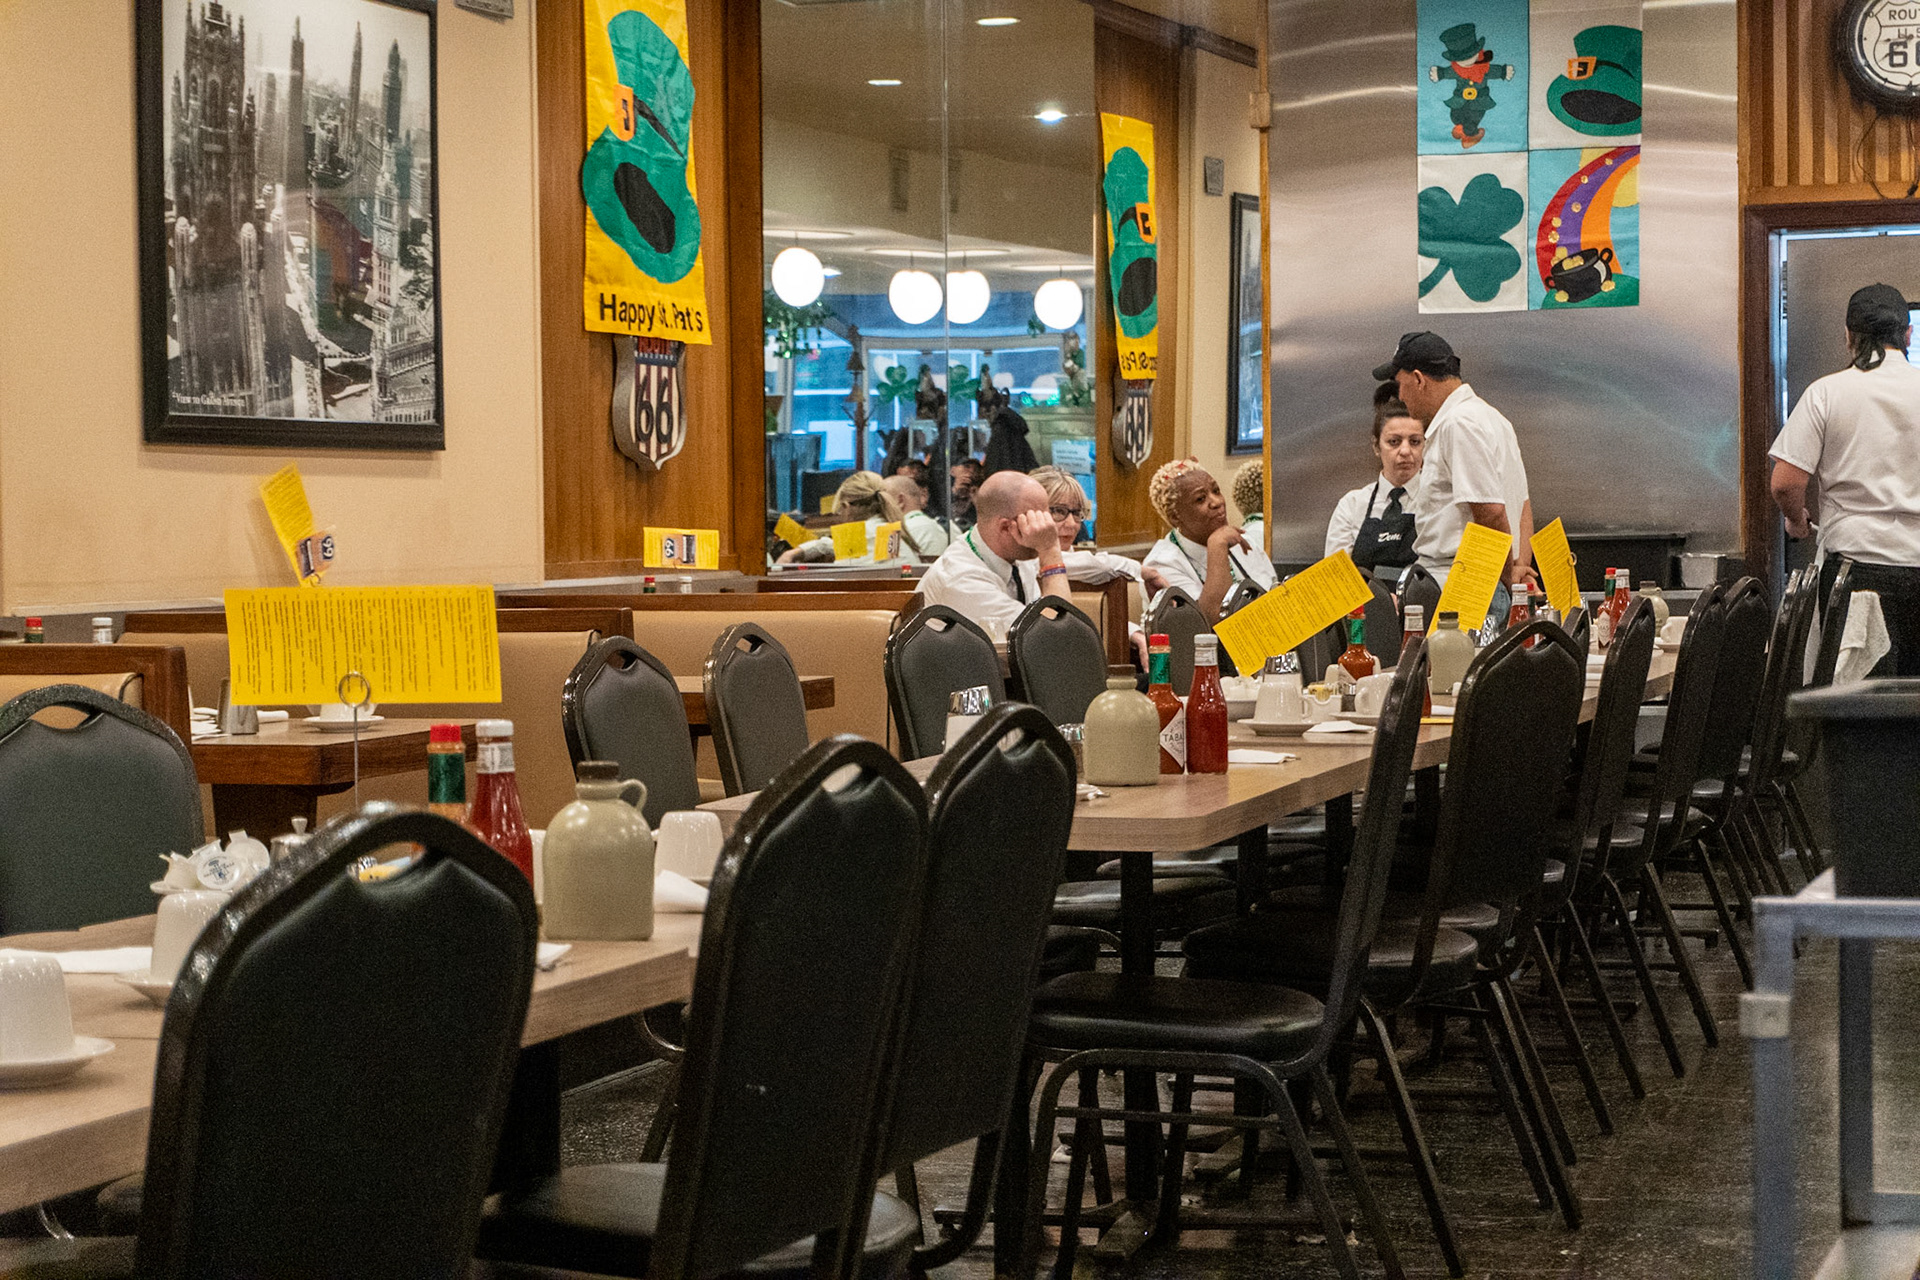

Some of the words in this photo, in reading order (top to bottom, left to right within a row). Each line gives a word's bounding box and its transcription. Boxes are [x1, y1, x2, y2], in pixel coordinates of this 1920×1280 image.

[1889, 41, 1920, 67] 6
[600, 293, 655, 332] Happy
[635, 374, 674, 443] 66
